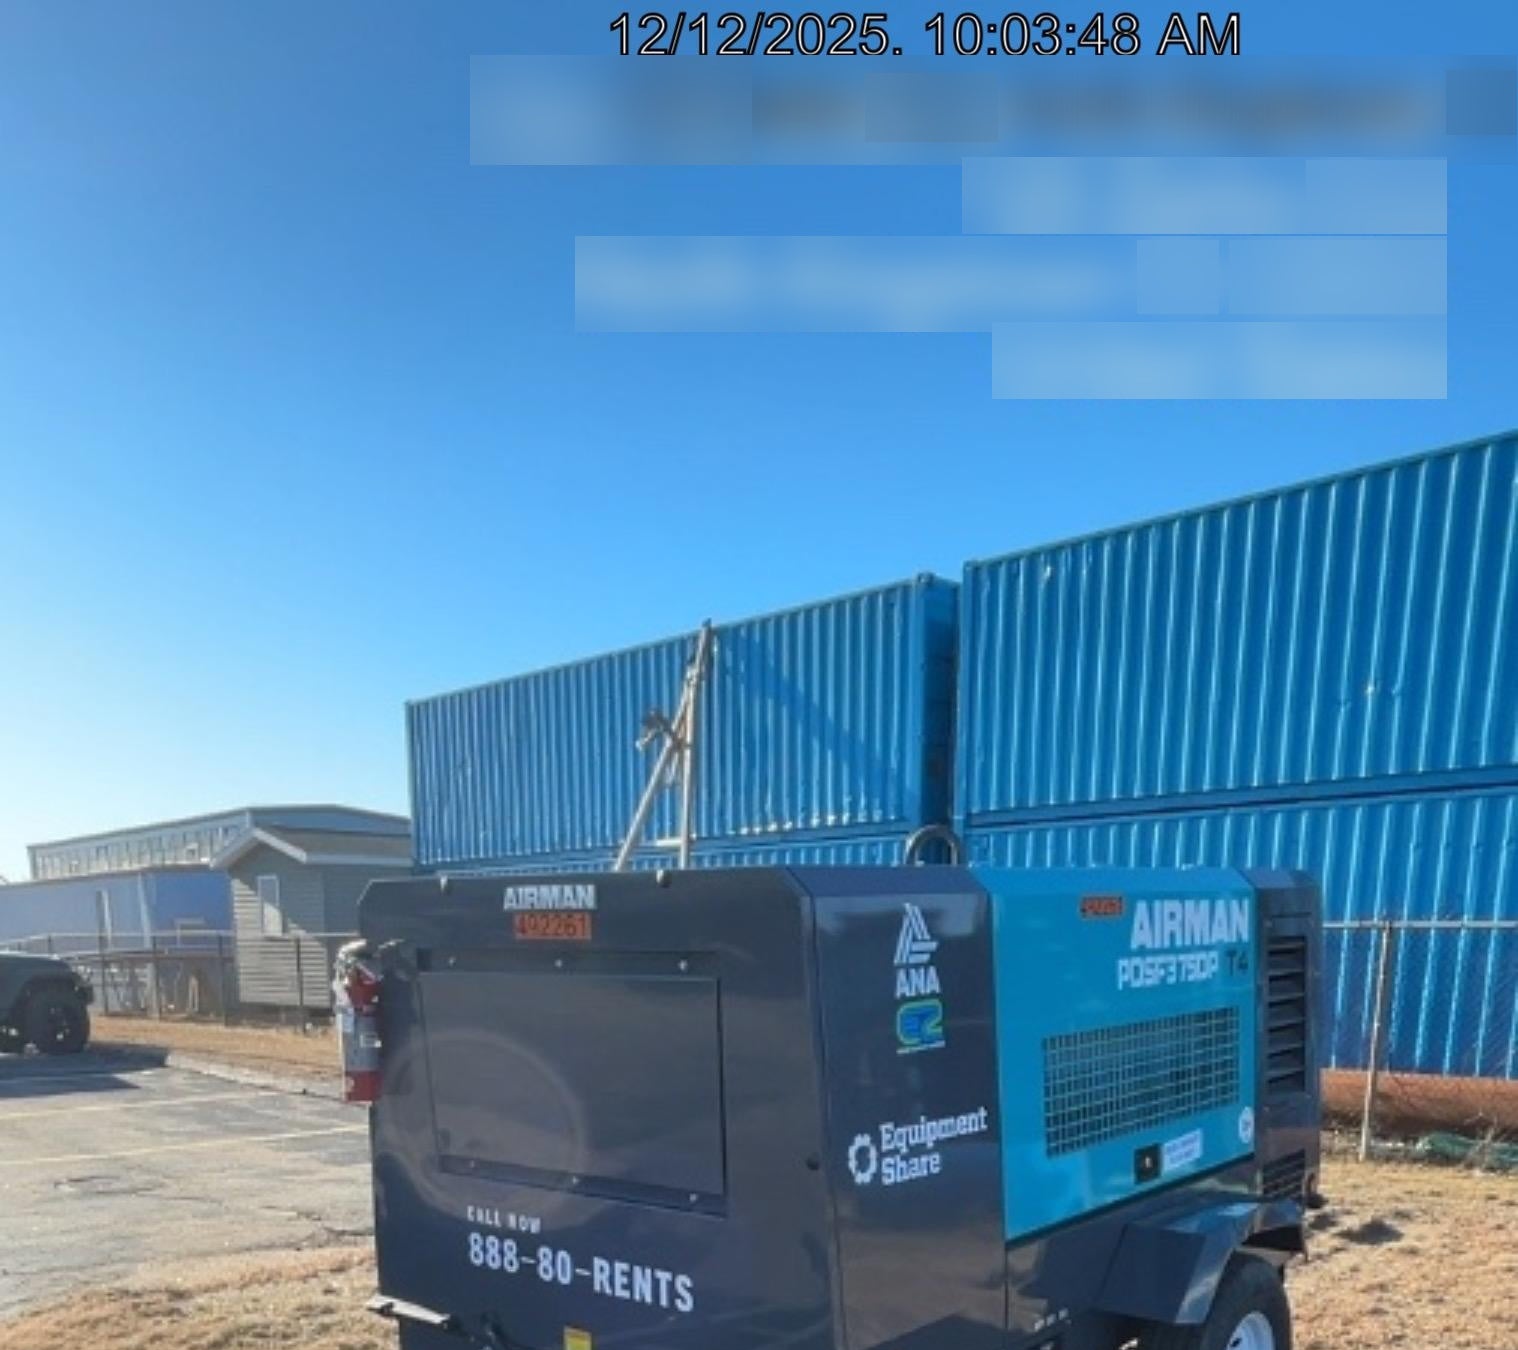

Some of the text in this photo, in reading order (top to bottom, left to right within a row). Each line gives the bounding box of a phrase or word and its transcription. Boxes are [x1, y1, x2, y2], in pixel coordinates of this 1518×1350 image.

[503, 884, 598, 911] AIRMAN
[1130, 897, 1250, 950] AIRMAN
[894, 965, 941, 998] ANA
[879, 1106, 988, 1154] Equipment
[881, 1151, 941, 1186] Share
[466, 1205, 541, 1234] CALL NOW
[468, 1231, 695, 1313] 888-80-RENTS
